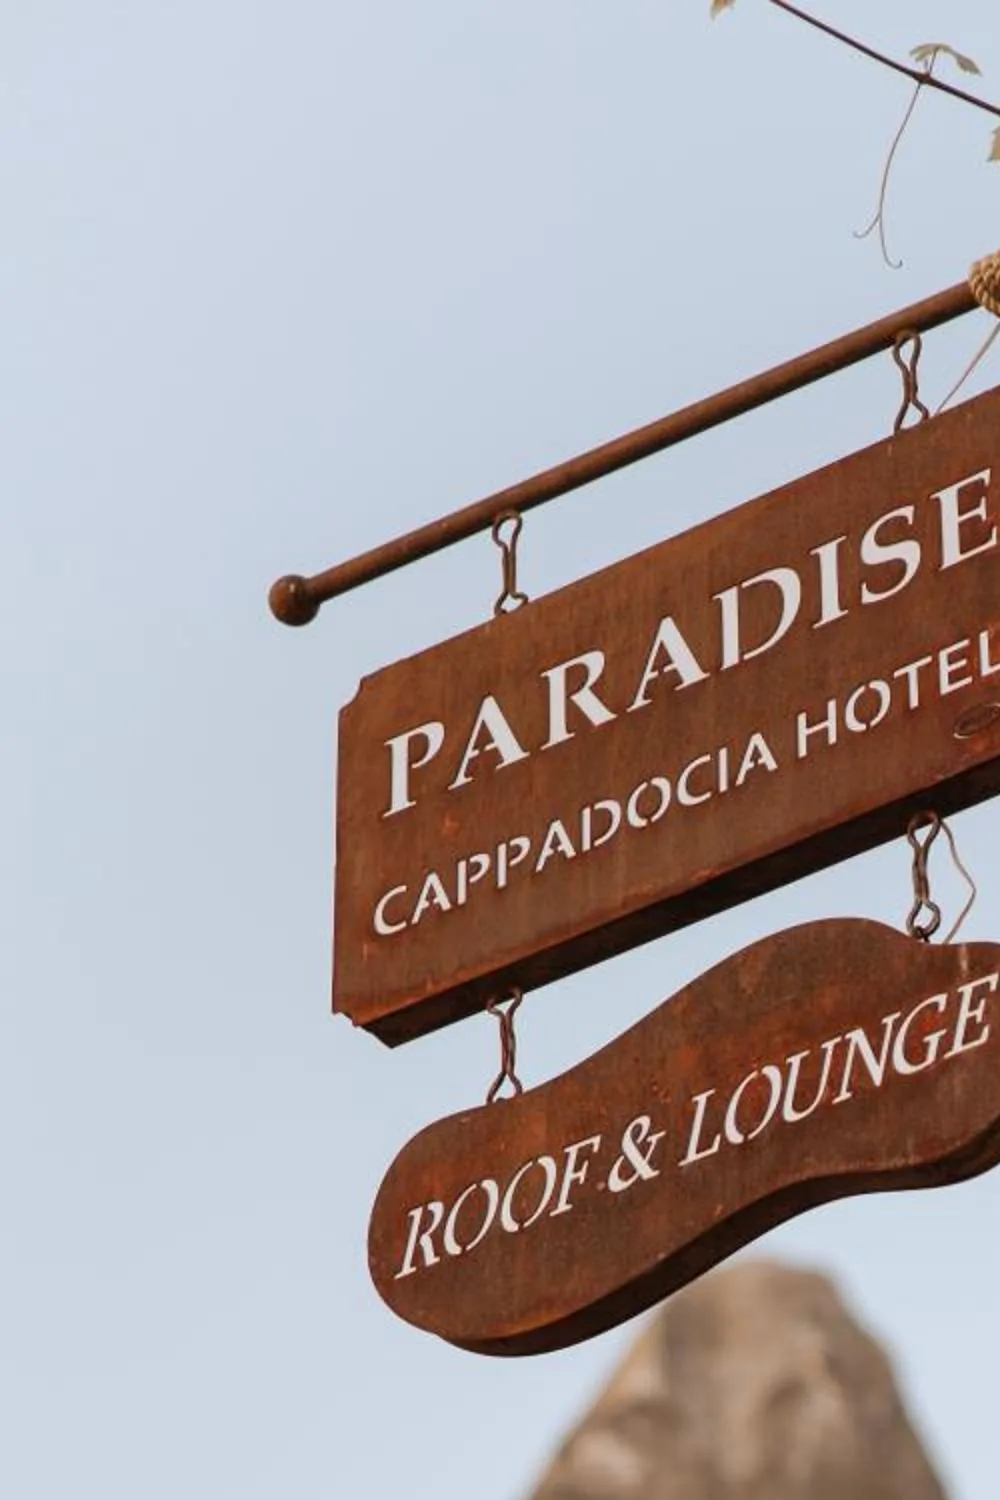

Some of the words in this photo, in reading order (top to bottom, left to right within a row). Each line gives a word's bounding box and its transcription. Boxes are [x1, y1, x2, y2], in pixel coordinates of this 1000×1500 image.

[382, 468, 999, 818] PARADISE
[373, 731, 779, 936] CAPPADOCIA
[394, 1134, 601, 1279] ROOF
[607, 1114, 666, 1193] &
[678, 973, 1000, 1168] LOUNGE
